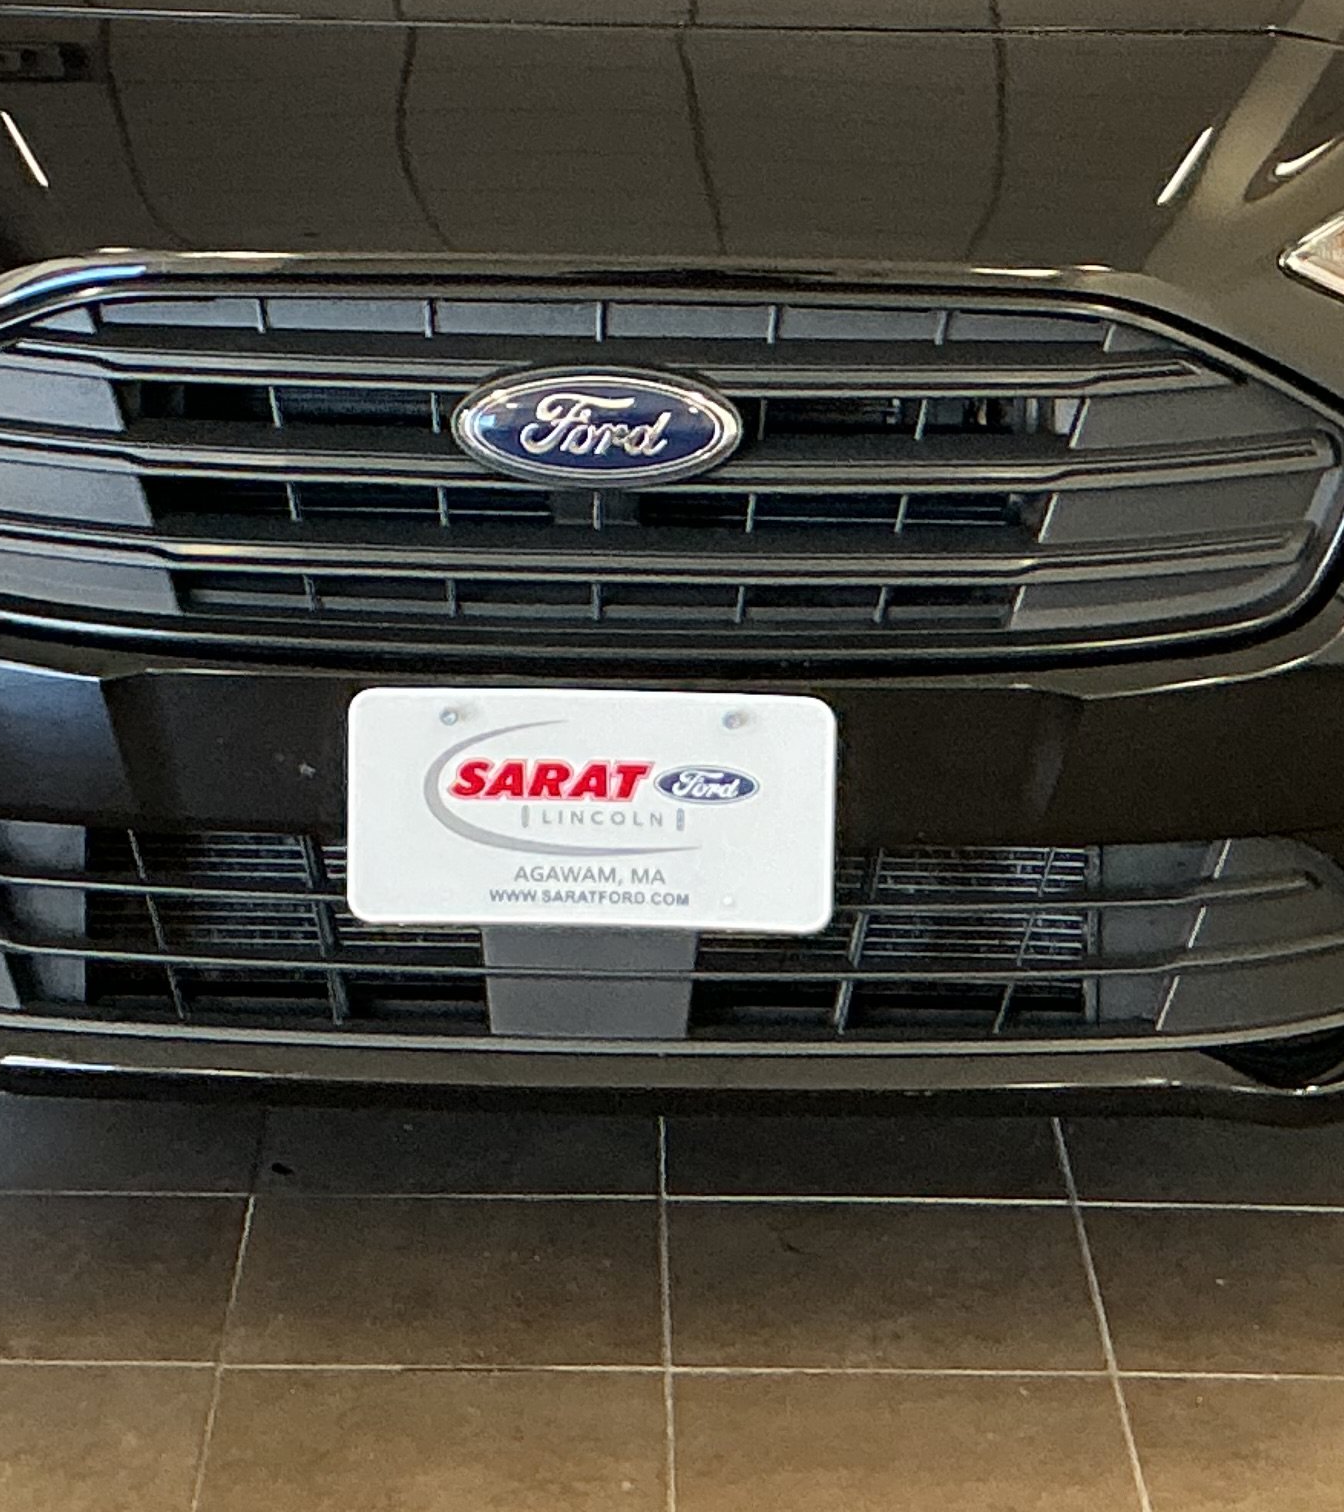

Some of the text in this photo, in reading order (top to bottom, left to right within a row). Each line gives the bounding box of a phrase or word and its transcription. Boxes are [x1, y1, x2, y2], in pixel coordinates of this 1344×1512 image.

[520, 393, 672, 455] Ford
[450, 758, 740, 800] SARAT Ford
[542, 810, 664, 828] LINCOLN
[513, 865, 667, 886] AGAWAM, MA
